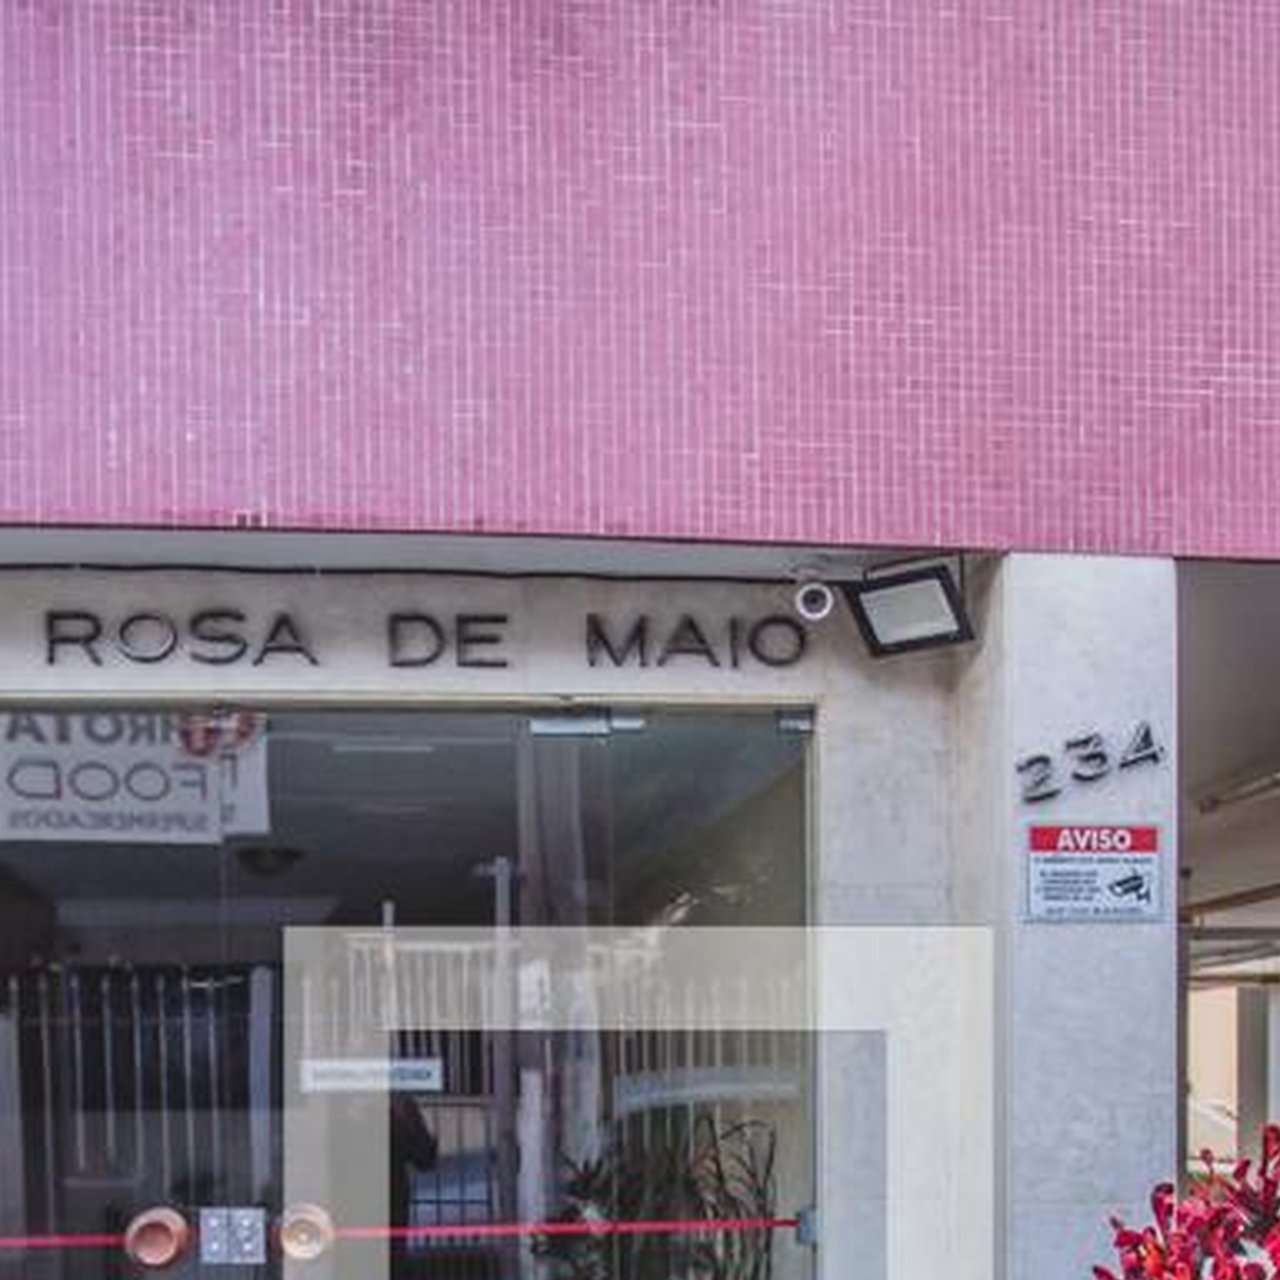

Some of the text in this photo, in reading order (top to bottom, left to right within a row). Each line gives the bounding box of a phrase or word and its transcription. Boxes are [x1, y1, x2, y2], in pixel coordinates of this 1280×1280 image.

[44, 608, 319, 668] ROSA
[387, 612, 508, 668] DE
[585, 612, 808, 669] MAIO
[1015, 719, 1165, 803] 234
[1057, 829, 1132, 850] AVISO
